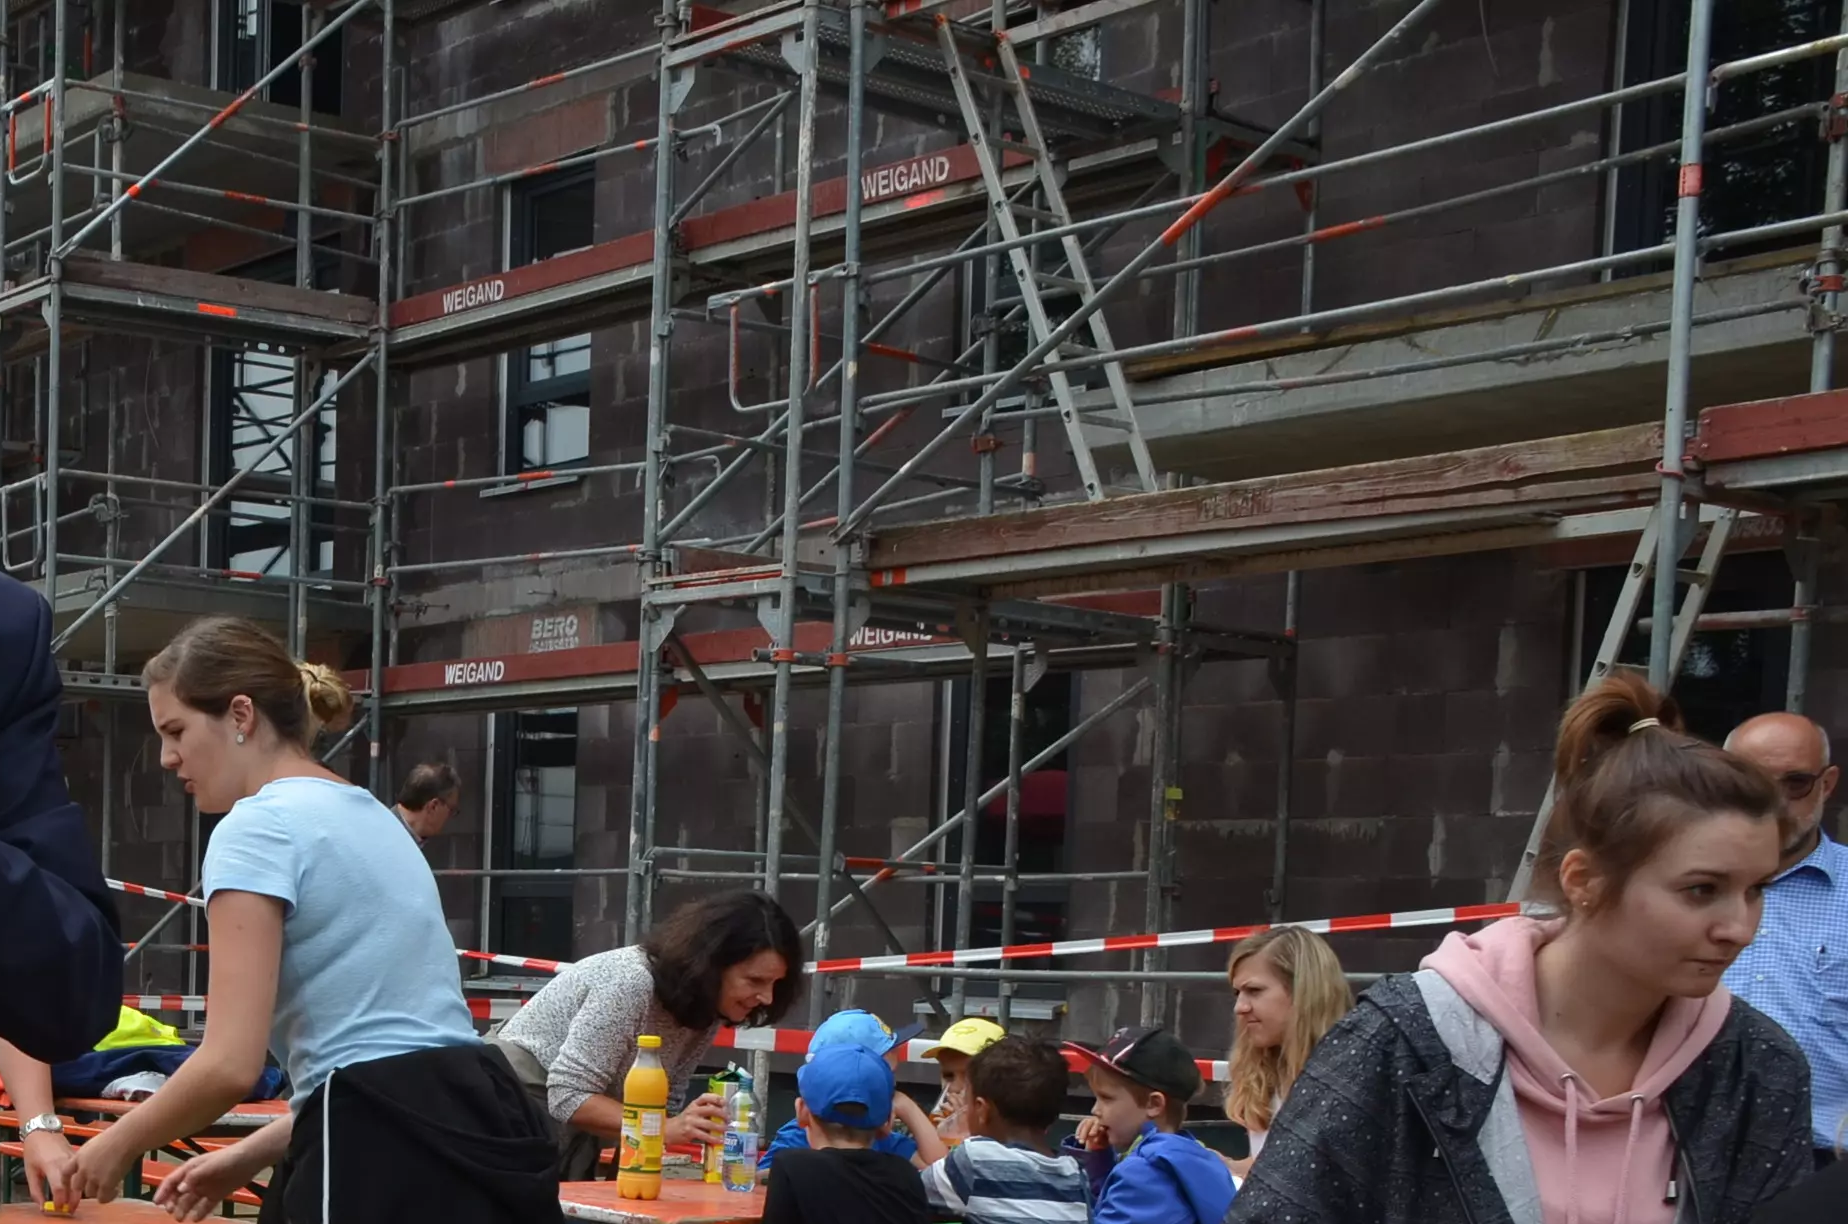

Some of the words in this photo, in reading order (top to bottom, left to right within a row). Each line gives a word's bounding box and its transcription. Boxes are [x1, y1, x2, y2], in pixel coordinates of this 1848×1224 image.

[861, 157, 949, 200] WEIGAND
[443, 280, 504, 314] WEIGAND
[531, 614, 578, 640] BERO
[445, 661, 504, 685] WEIGAND
